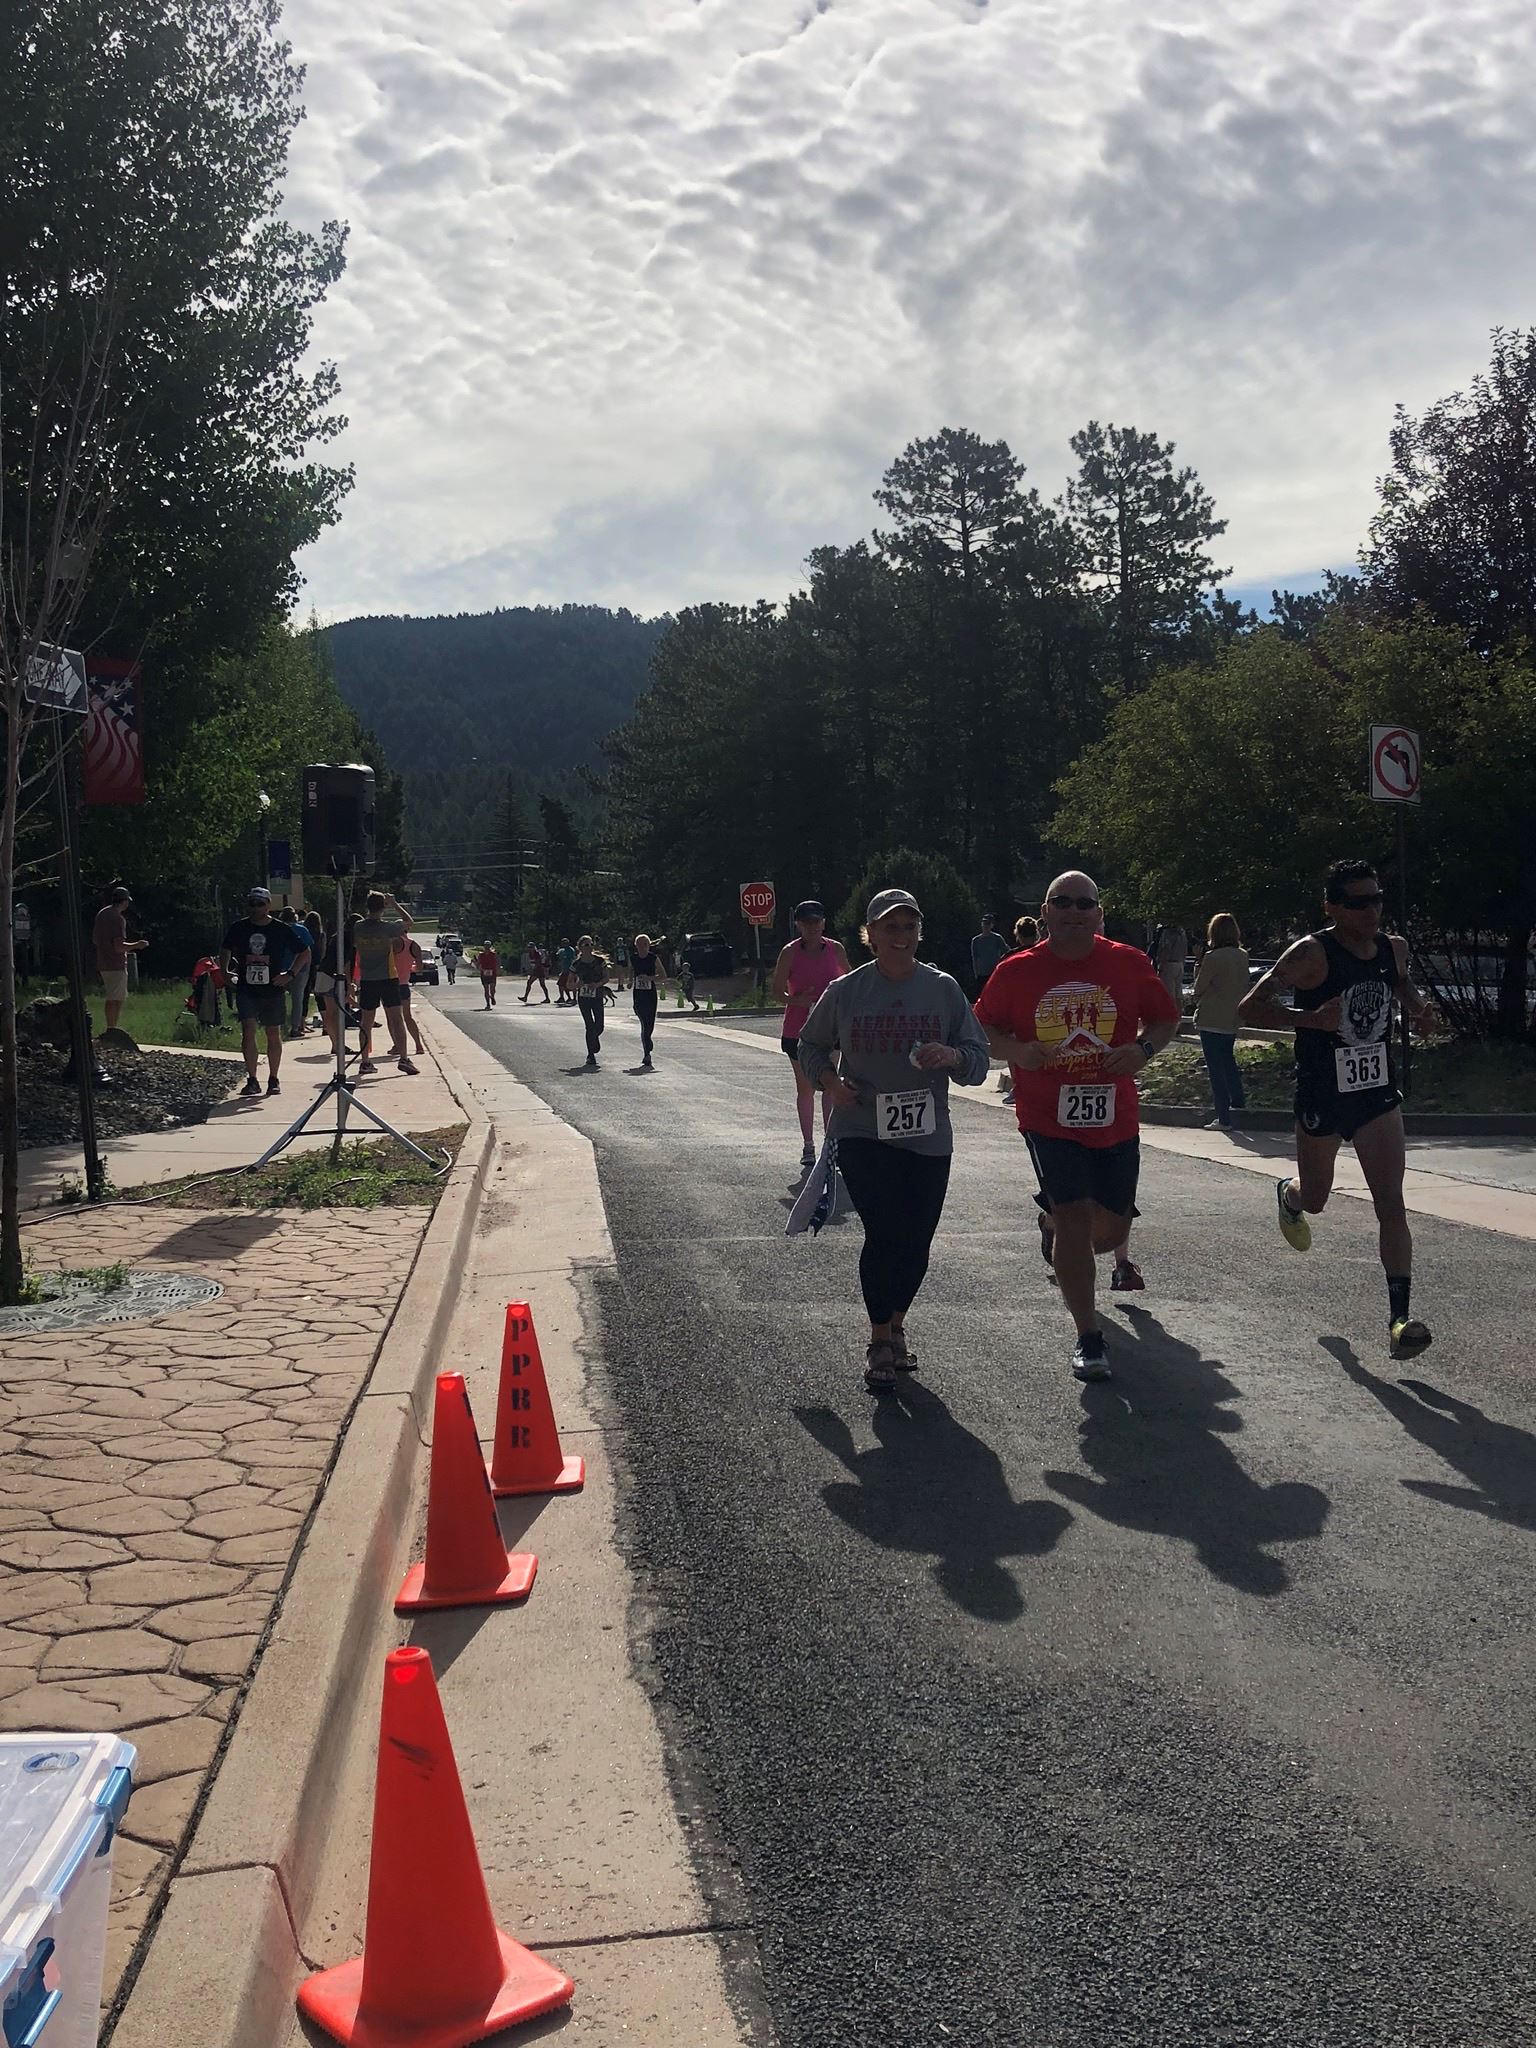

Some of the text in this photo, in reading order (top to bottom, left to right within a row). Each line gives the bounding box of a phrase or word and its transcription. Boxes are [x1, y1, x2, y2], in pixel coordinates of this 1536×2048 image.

[743, 893, 772, 907] STOP
[251, 971, 263, 982] 76
[1346, 1056, 1380, 1084] 363
[887, 1102, 926, 1131] 257
[1067, 1095, 1106, 1120] 258
